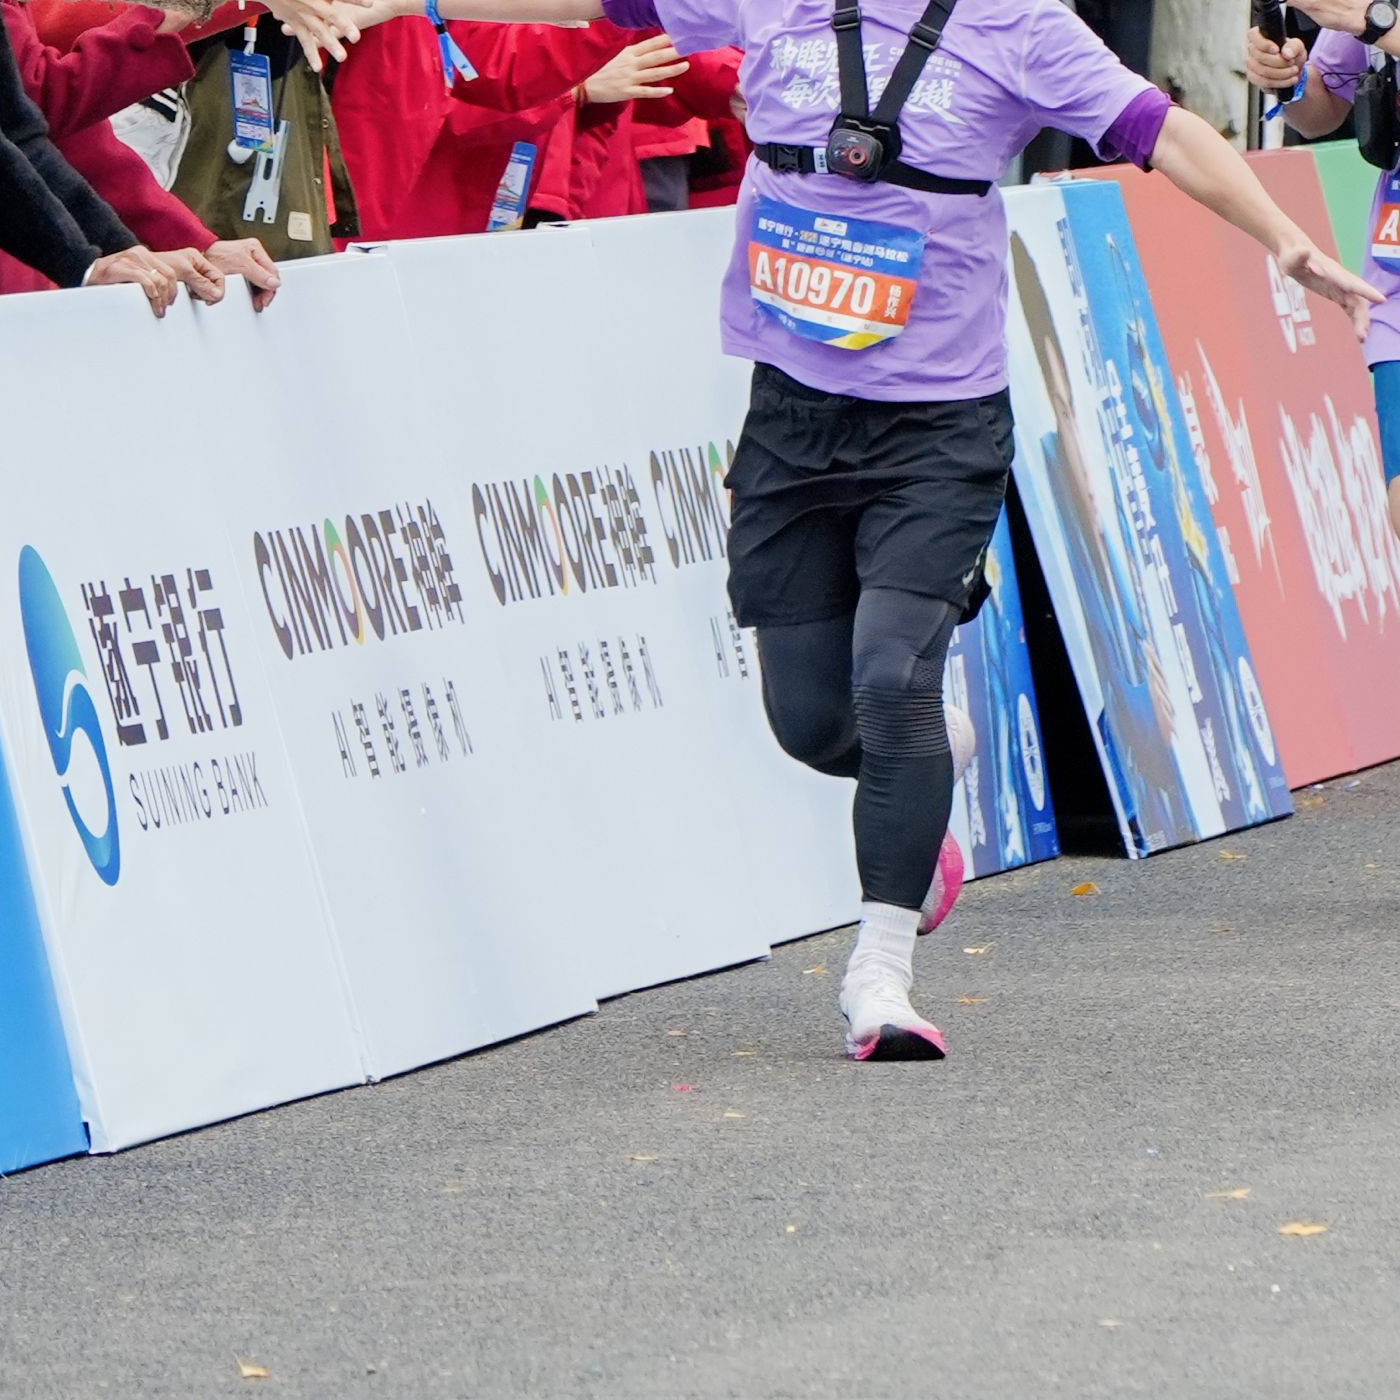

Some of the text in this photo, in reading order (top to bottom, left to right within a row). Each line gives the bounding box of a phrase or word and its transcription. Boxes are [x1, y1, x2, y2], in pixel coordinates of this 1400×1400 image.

[754, 250, 876, 316] A10970
[254, 497, 465, 661] CINMOORE神眸
[472, 463, 656, 607] CINMOORE神眸
[81, 568, 243, 748] 遂宁银行
[130, 751, 269, 832] SUINING BANK
